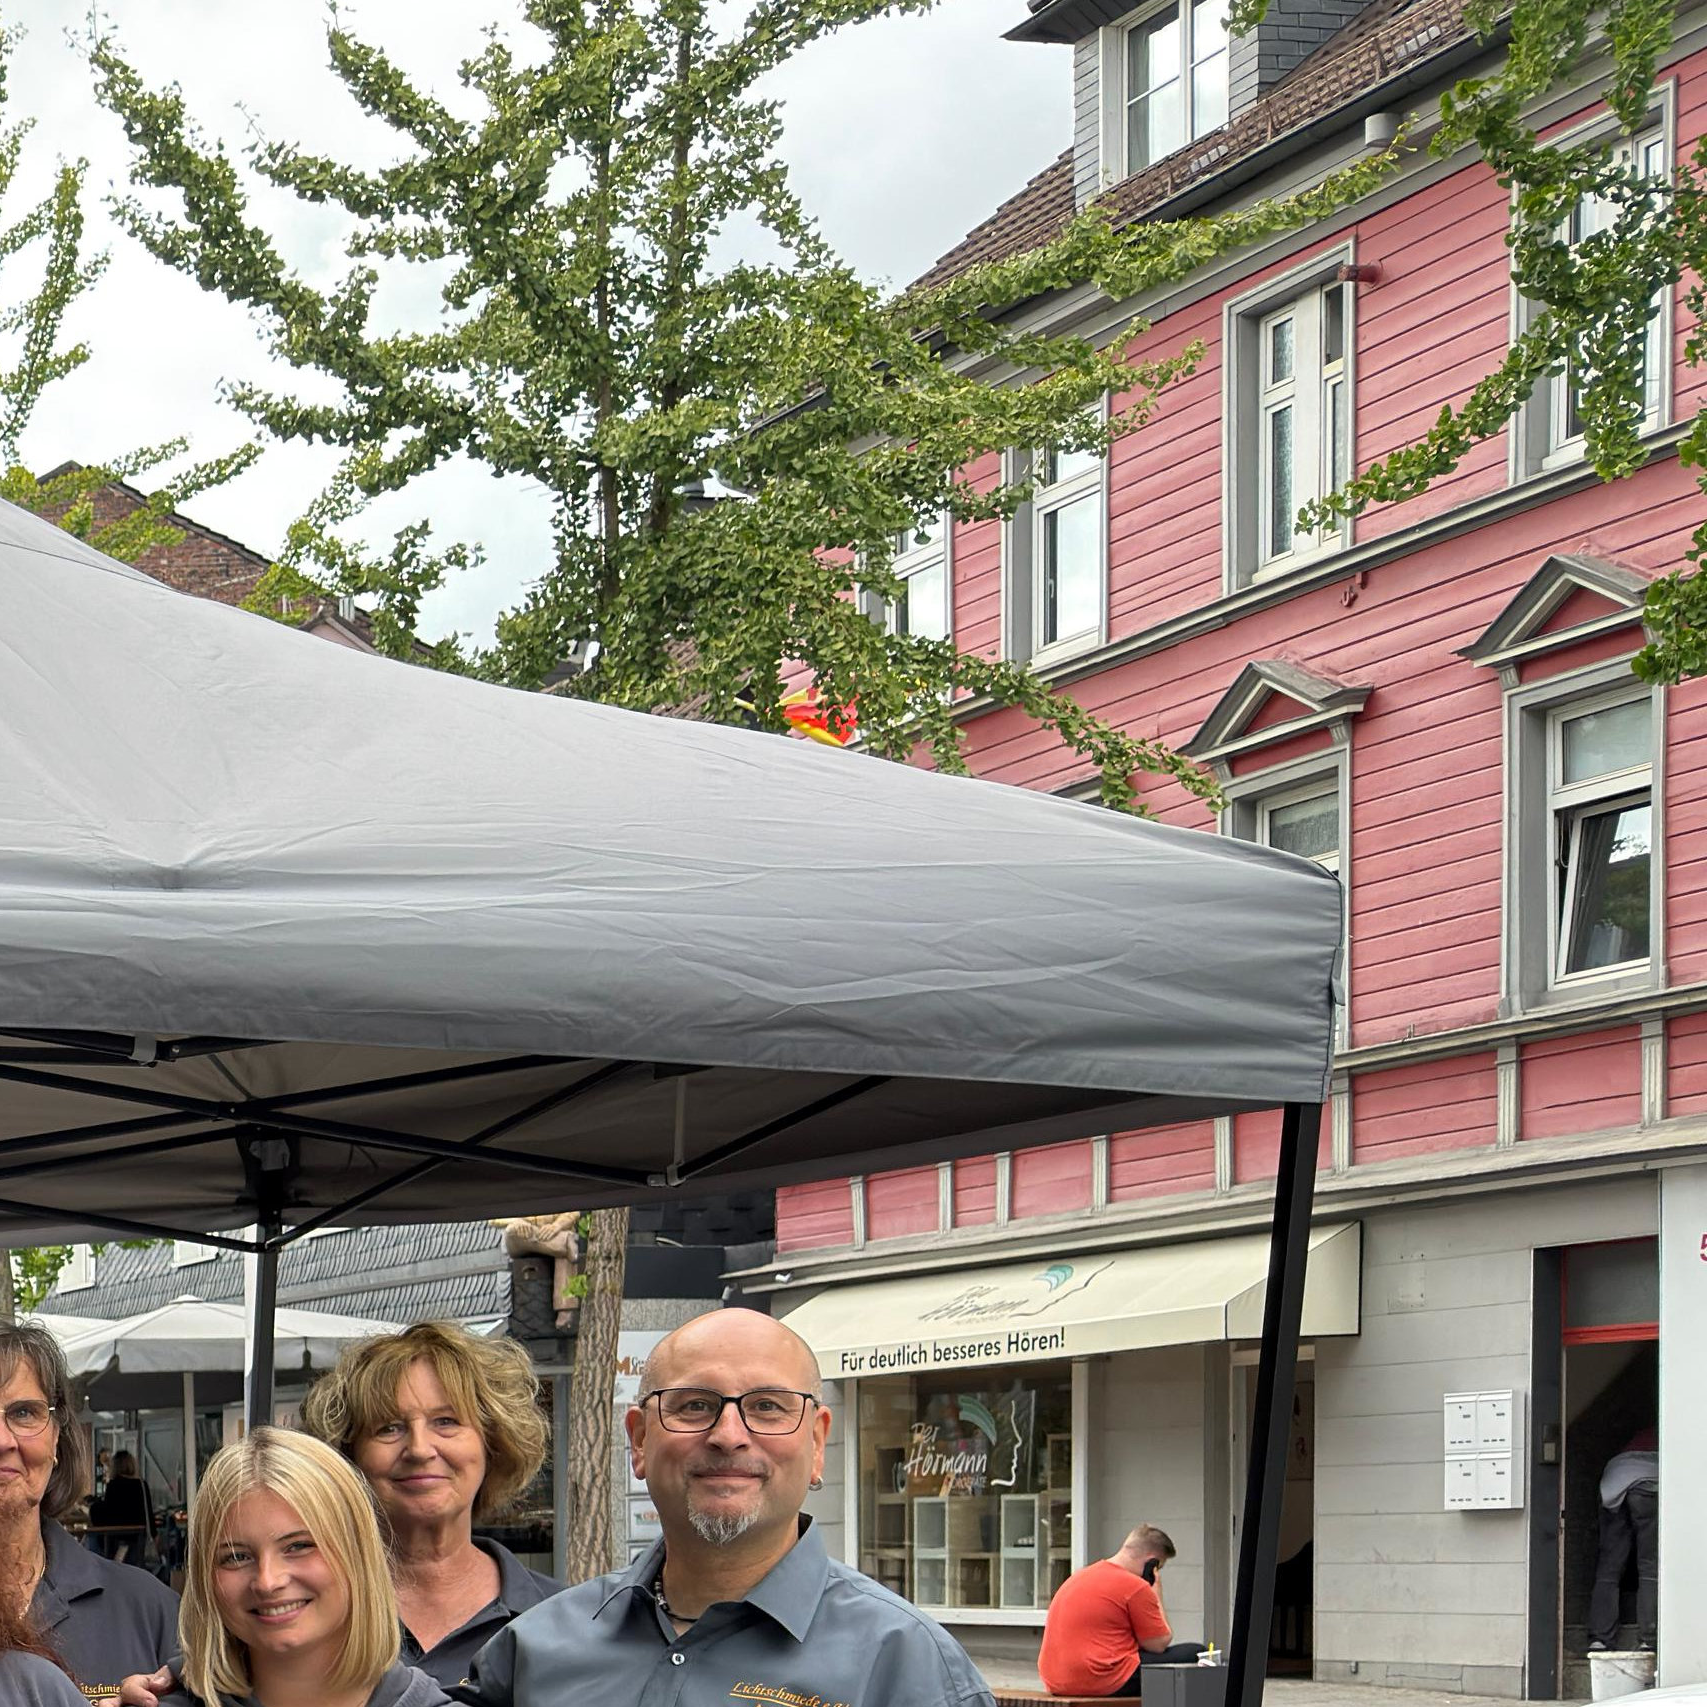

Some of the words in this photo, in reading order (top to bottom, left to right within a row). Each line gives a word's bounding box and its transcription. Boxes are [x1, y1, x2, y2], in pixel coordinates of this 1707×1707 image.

[841, 1351, 864, 1372] Für
[868, 1344, 928, 1369] deutlich
[933, 1339, 1001, 1363] besseres
[1007, 1326, 1066, 1354] Hören!
[911, 1421, 940, 1444] Der
[904, 1443, 987, 1477] Hörmann
